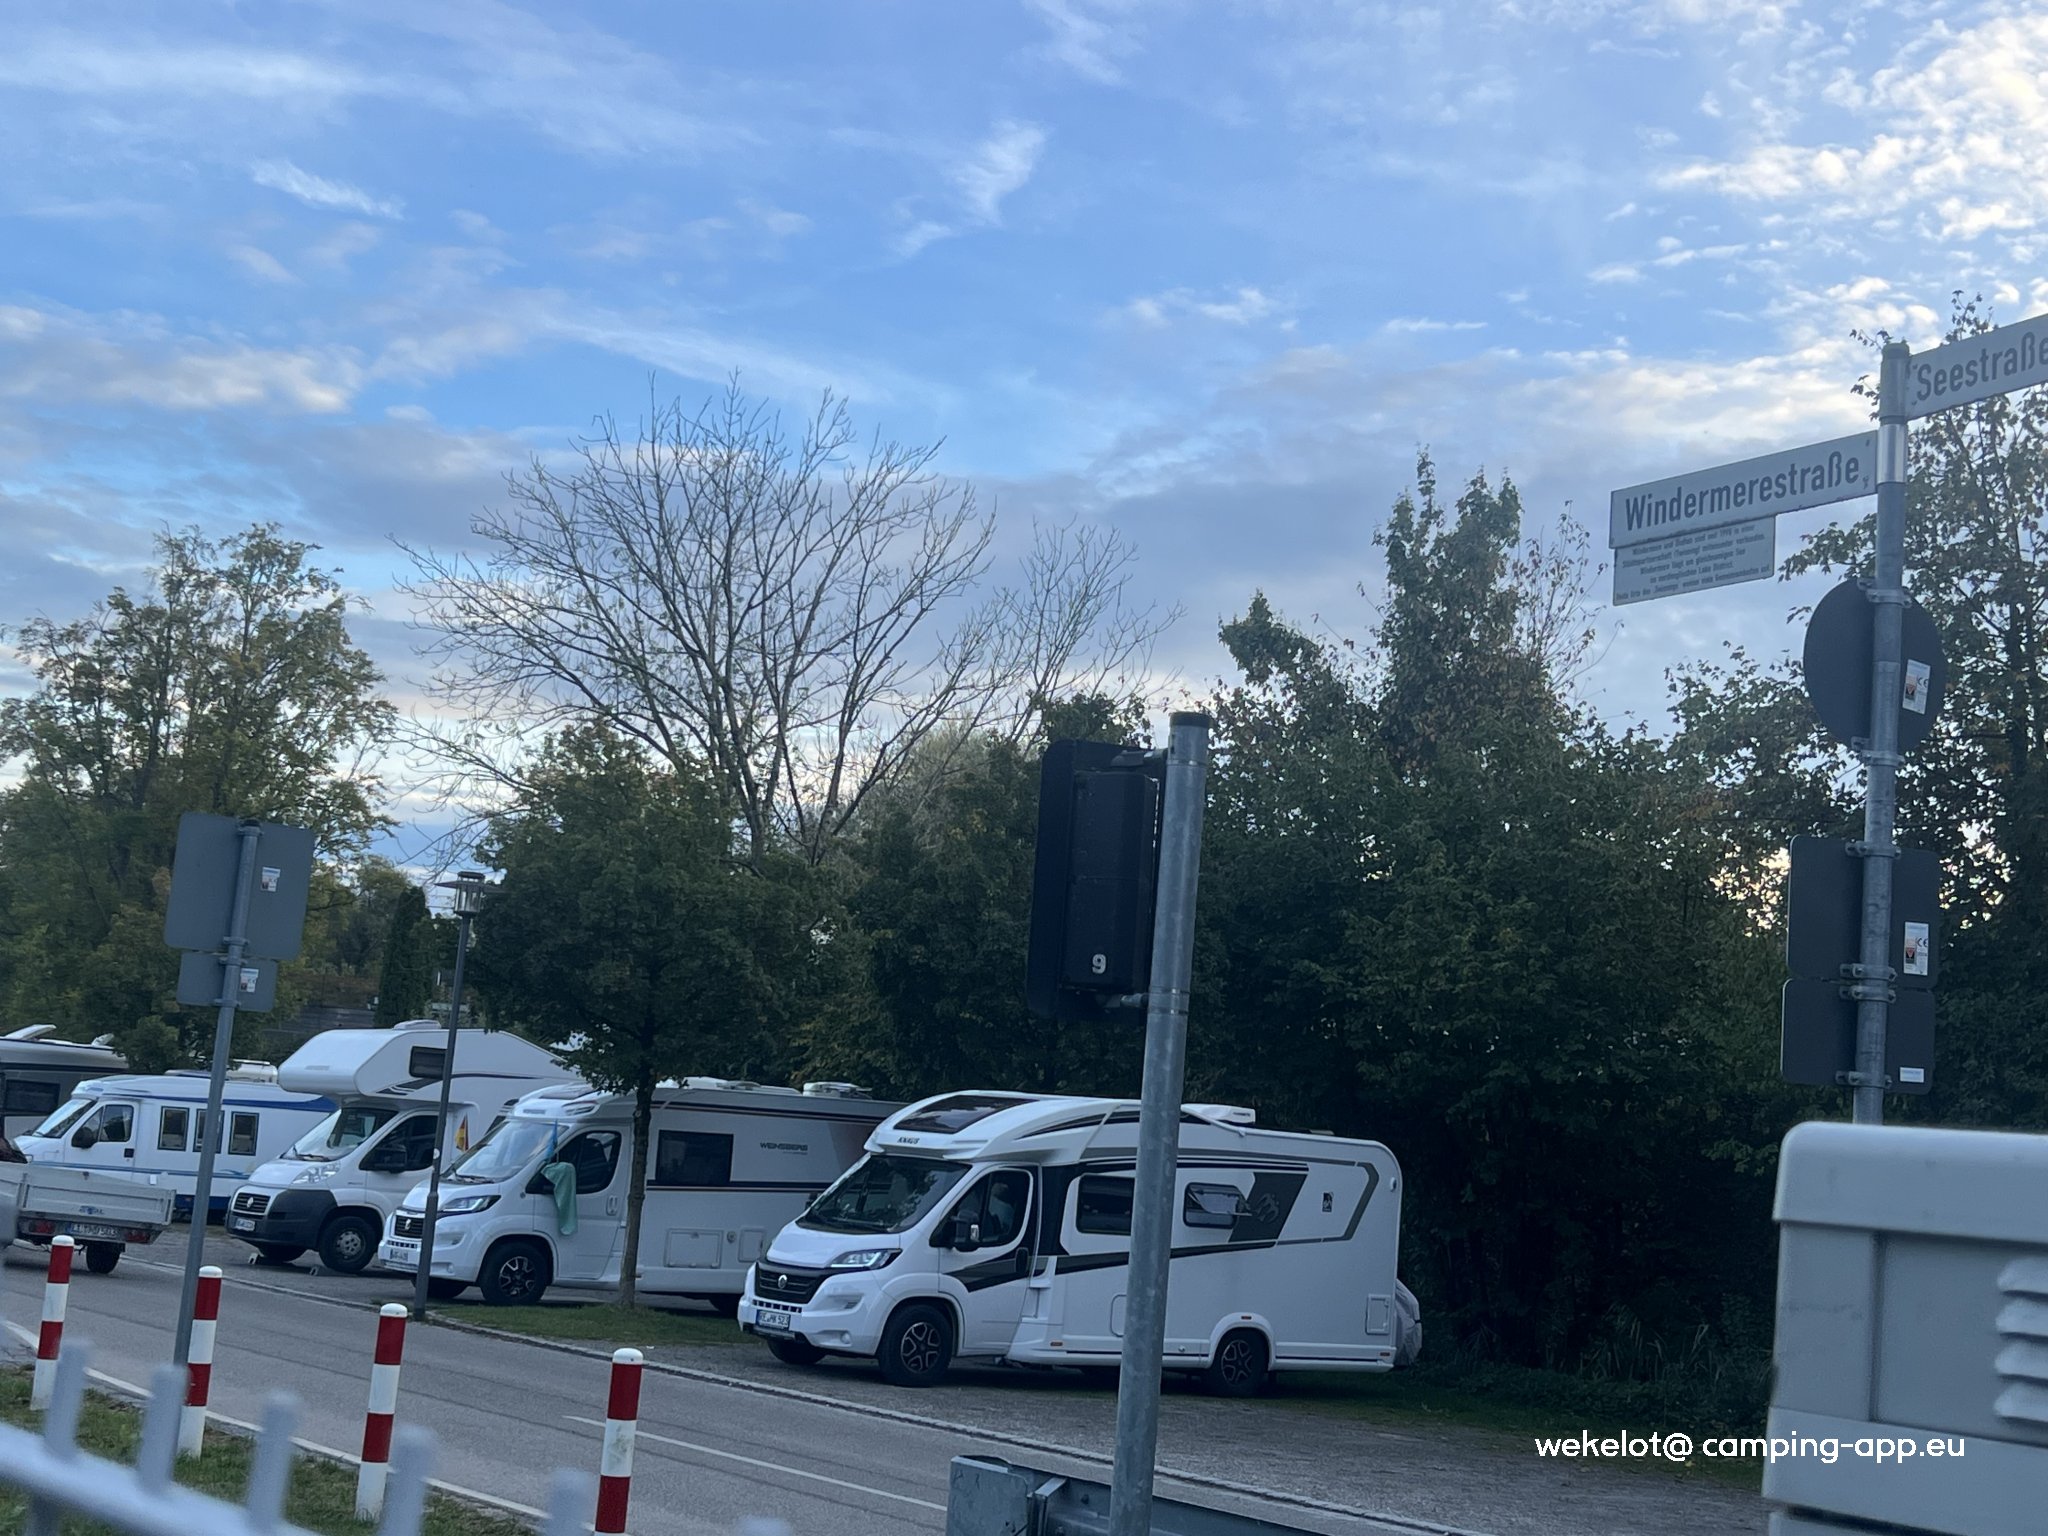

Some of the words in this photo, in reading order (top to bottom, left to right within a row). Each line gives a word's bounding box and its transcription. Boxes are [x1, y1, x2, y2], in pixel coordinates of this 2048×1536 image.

[1917, 331, 2048, 401] Seestraße
[1626, 451, 1859, 531] Windermerestraße
[1092, 953, 1106, 974] 9
